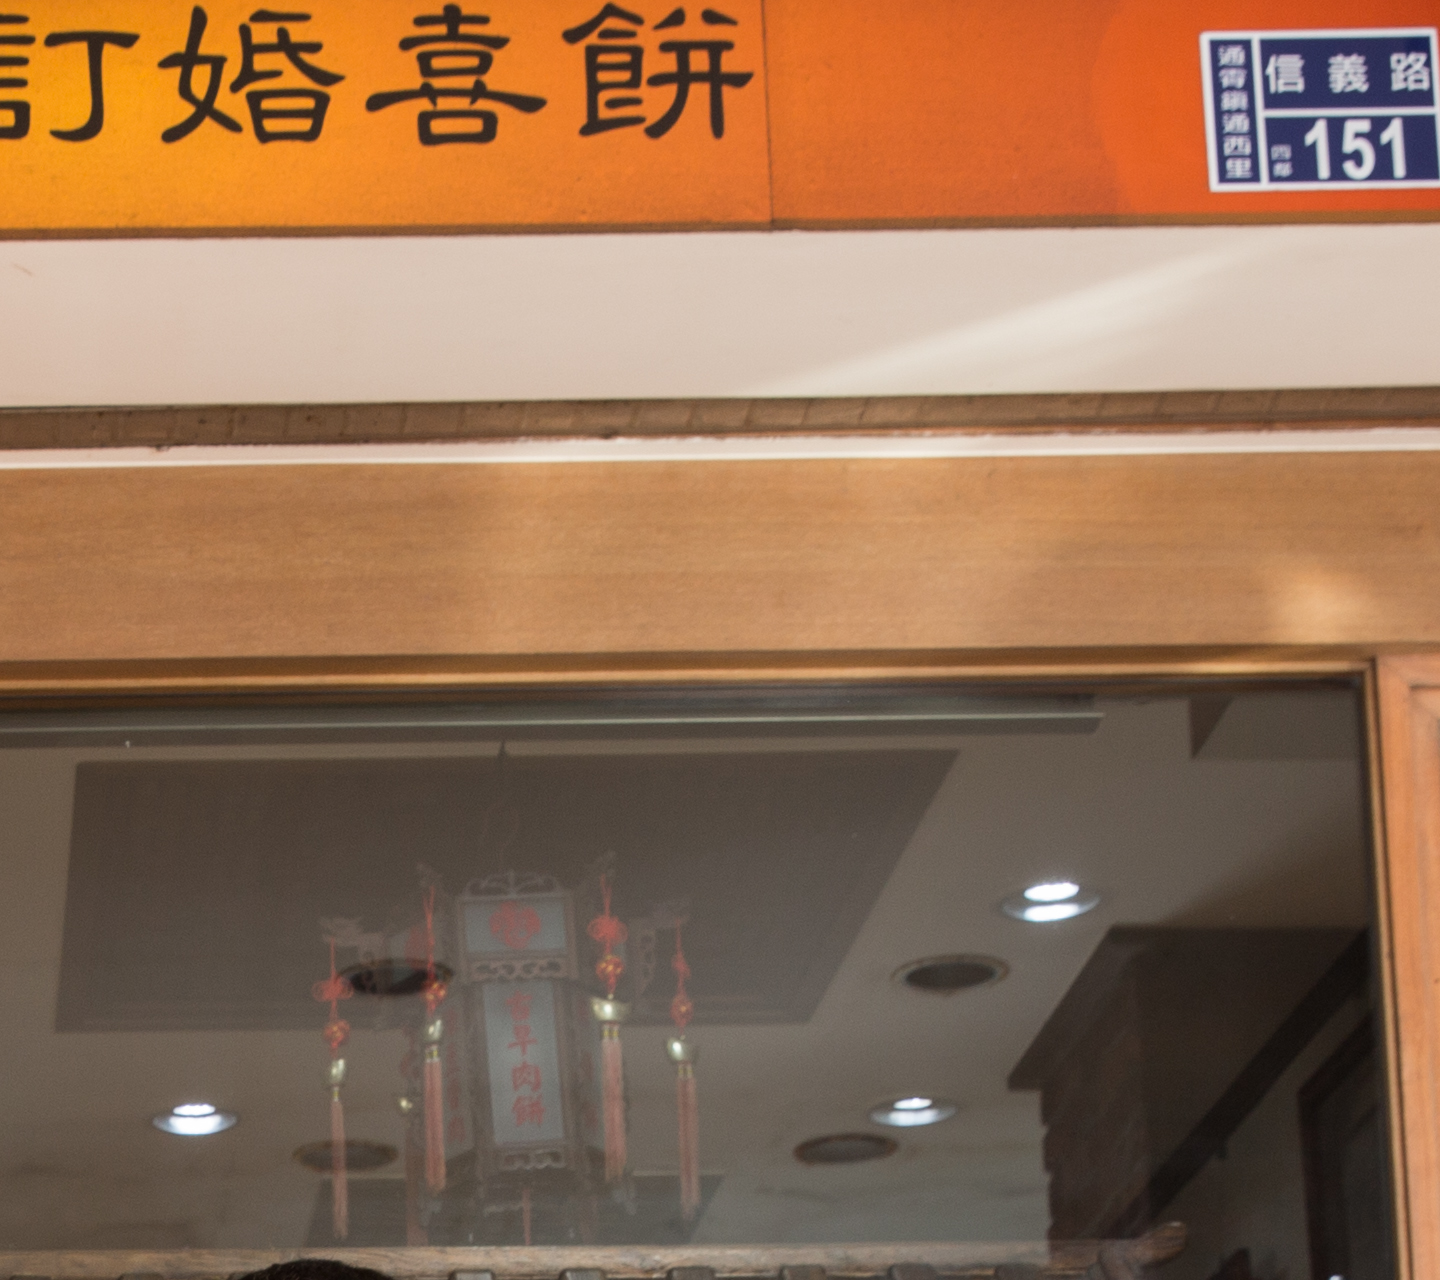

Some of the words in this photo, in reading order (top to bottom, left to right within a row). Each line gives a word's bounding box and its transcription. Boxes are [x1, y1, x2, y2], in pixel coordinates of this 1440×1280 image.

[1264, 51, 1431, 94] 信義路
[1304, 117, 1407, 181] 151
